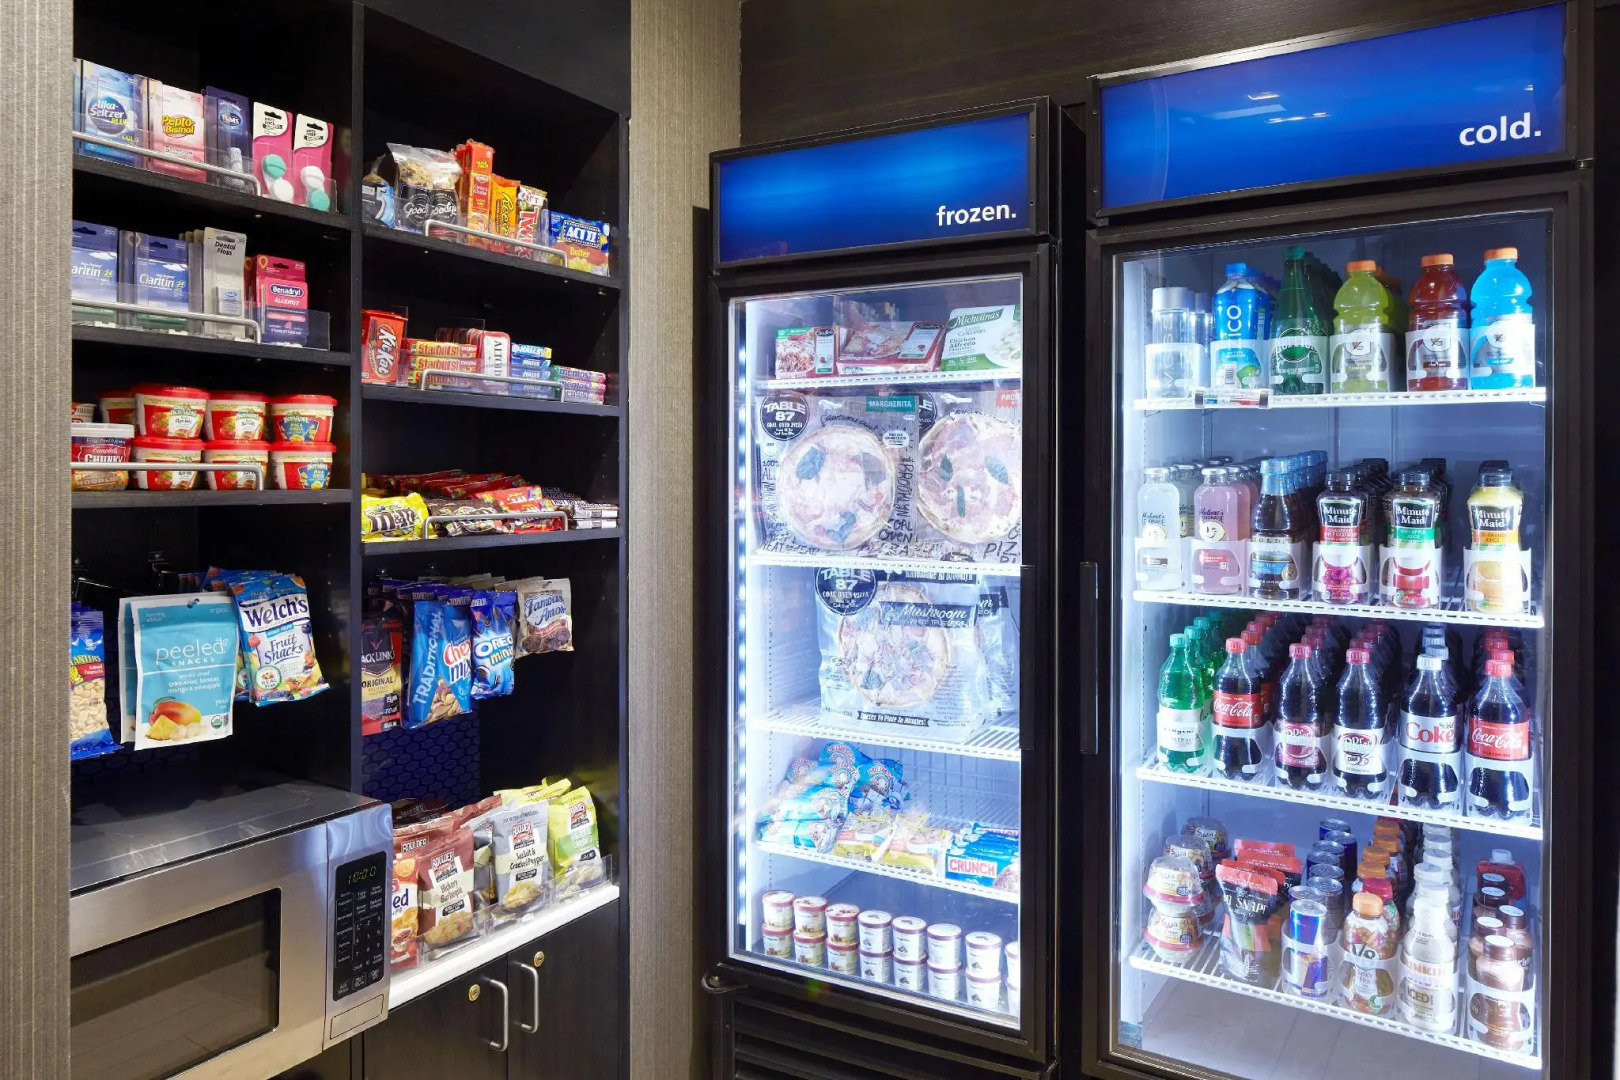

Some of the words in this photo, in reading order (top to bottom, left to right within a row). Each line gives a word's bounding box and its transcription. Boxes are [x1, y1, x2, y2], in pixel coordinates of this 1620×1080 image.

[91, 99, 119, 110] Alka-
[89, 107, 125, 118] Seltzer
[161, 114, 195, 126] Pepto-
[165, 125, 194, 135] Bismol
[1459, 111, 1542, 146] cold.
[936, 205, 1017, 226] frozen.
[214, 241, 236, 251] Dental
[216, 248, 233, 256] Floss
[71, 264, 101, 277] aritin
[140, 273, 175, 288] Claritin
[272, 285, 302, 297] Benadryl
[1227, 304, 1242, 338] ICO
[565, 389, 589, 400] entos
[763, 402, 806, 415] TABLE
[868, 400, 912, 408] MARGHERITA
[775, 411, 796, 422] 87
[1323, 505, 1358, 516] Minute
[1396, 505, 1431, 517] Minute
[1474, 509, 1511, 520] Minute
[1328, 514, 1353, 524] Maid
[1401, 515, 1426, 525] Maid
[1479, 518, 1507, 528] Maid
[984, 541, 1020, 560] PIZ
[821, 568, 872, 583] TABLE
[835, 578, 858, 590] 87
[243, 597, 309, 628] Welch's
[524, 596, 563, 619] Famous
[900, 603, 967, 620] Mushroom
[534, 604, 567, 626] Amos
[269, 633, 298, 653] Fruit
[474, 635, 514, 659] OREO
[156, 639, 225, 666] peeled
[264, 643, 304, 665] Snacks
[412, 611, 443, 705] TRADITIONAL
[443, 640, 471, 667] Chex
[73, 655, 102, 666] ANTERS
[361, 675, 394, 689] ORIGINAL
[1406, 721, 1455, 744] Coke
[949, 858, 996, 877] CRUNCH
